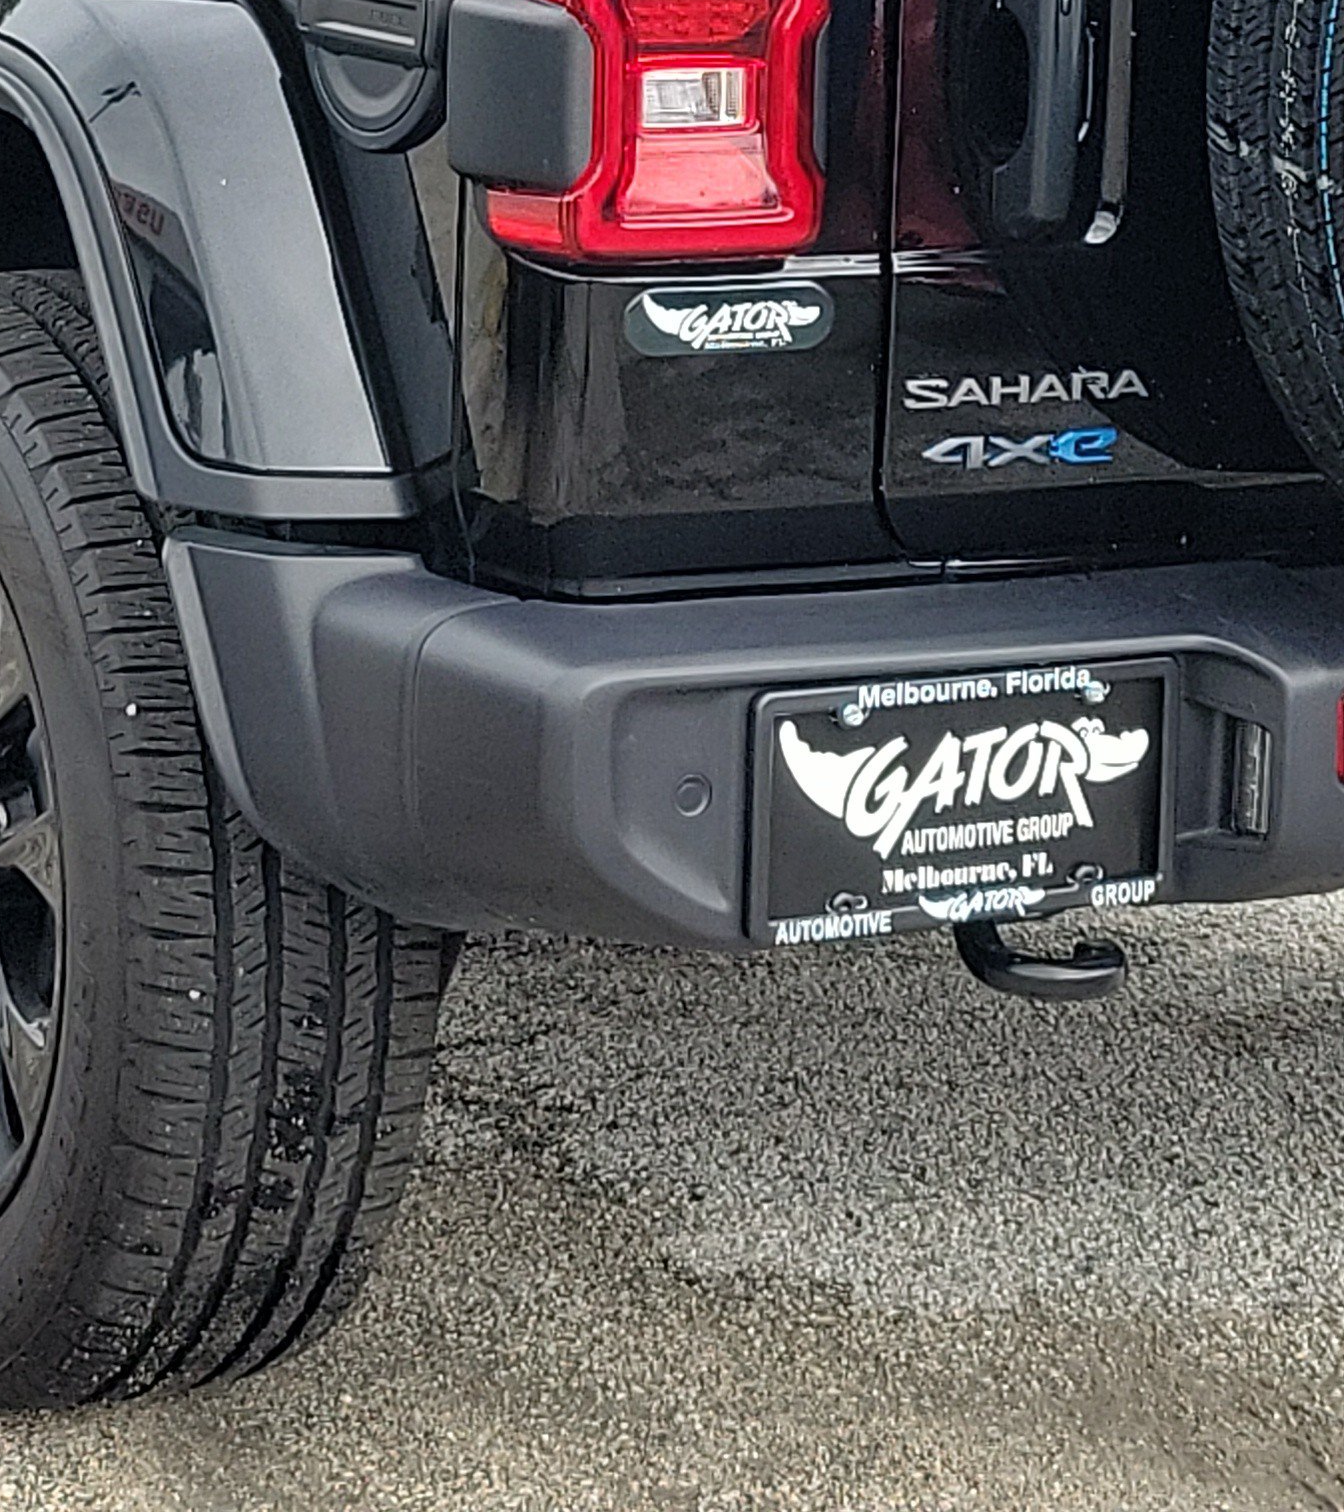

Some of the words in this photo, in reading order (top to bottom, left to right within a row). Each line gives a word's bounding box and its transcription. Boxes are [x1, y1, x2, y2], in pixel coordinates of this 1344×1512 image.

[678, 300, 793, 350] GATOR
[903, 365, 1150, 410] SAHARA
[857, 674, 998, 710] Melbourne,
[1005, 665, 1092, 696] Florida
[844, 720, 1094, 860] GATOR
[900, 819, 1015, 857] AUTOMOTIVE
[1016, 811, 1074, 845] GROUP
[881, 861, 1018, 895] Melbourne,
[1022, 852, 1054, 878] FL
[774, 911, 893, 946] AUTOMOTIVE
[949, 886, 1028, 921] GATOR
[1091, 879, 1156, 906] GROUP
